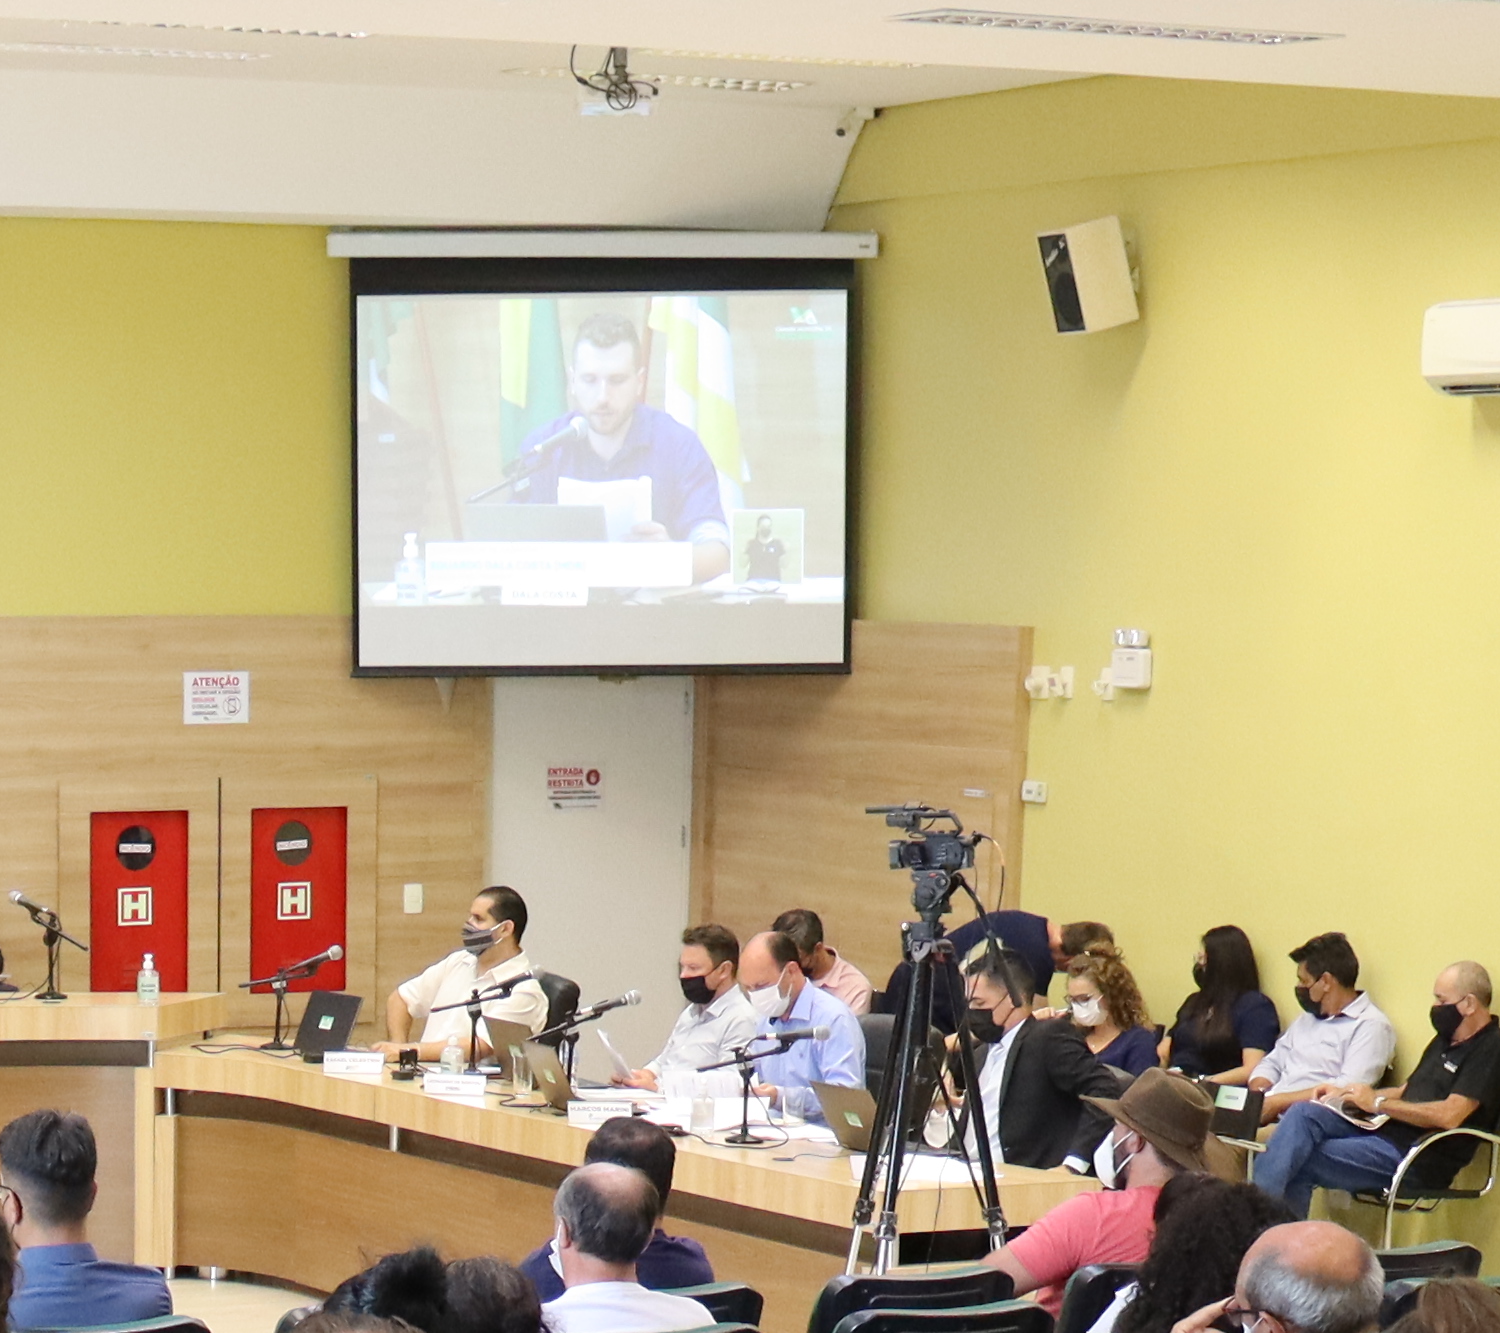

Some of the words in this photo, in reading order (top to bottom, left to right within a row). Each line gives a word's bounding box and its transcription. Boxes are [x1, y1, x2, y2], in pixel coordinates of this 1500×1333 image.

[192, 675, 239, 688] ATENÇÃO
[548, 779, 583, 787] RESTRITA
[123, 893, 147, 919] H
[282, 888, 306, 914] H
